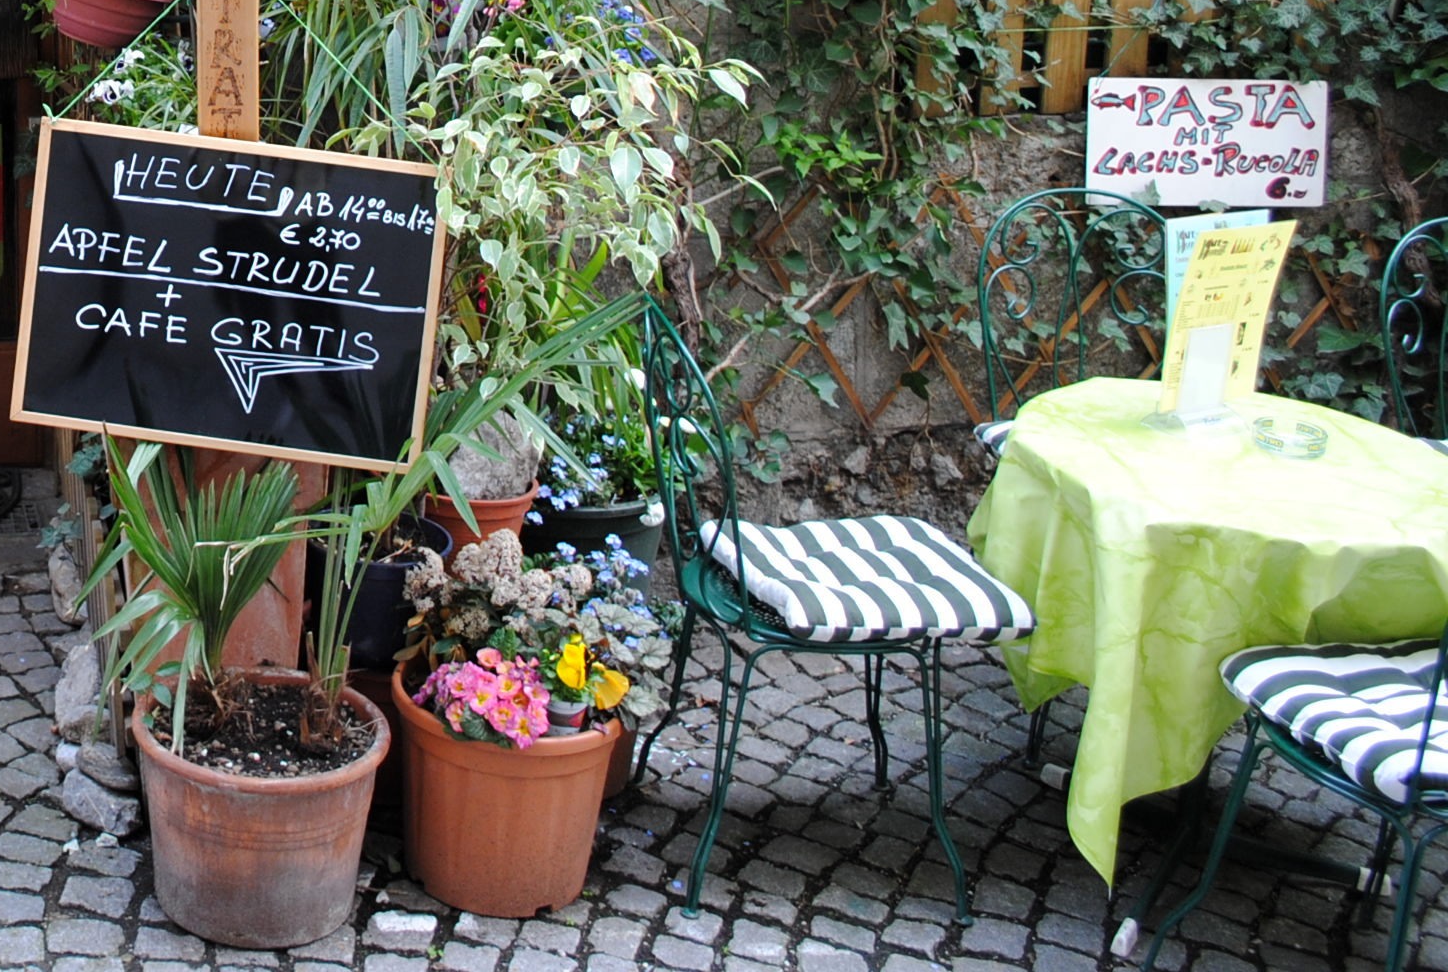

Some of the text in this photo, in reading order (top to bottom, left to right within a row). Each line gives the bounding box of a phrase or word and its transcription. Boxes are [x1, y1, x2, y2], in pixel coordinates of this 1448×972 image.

[1136, 83, 1316, 129] PASTA
[1173, 122, 1233, 147] MIT
[125, 152, 276, 204] HEUTE
[294, 191, 334, 217] AB
[49, 223, 381, 299] APFEL STRUDEL
[279, 223, 361, 253] € 2,70
[74, 303, 381, 364] CAFE GRATIS
